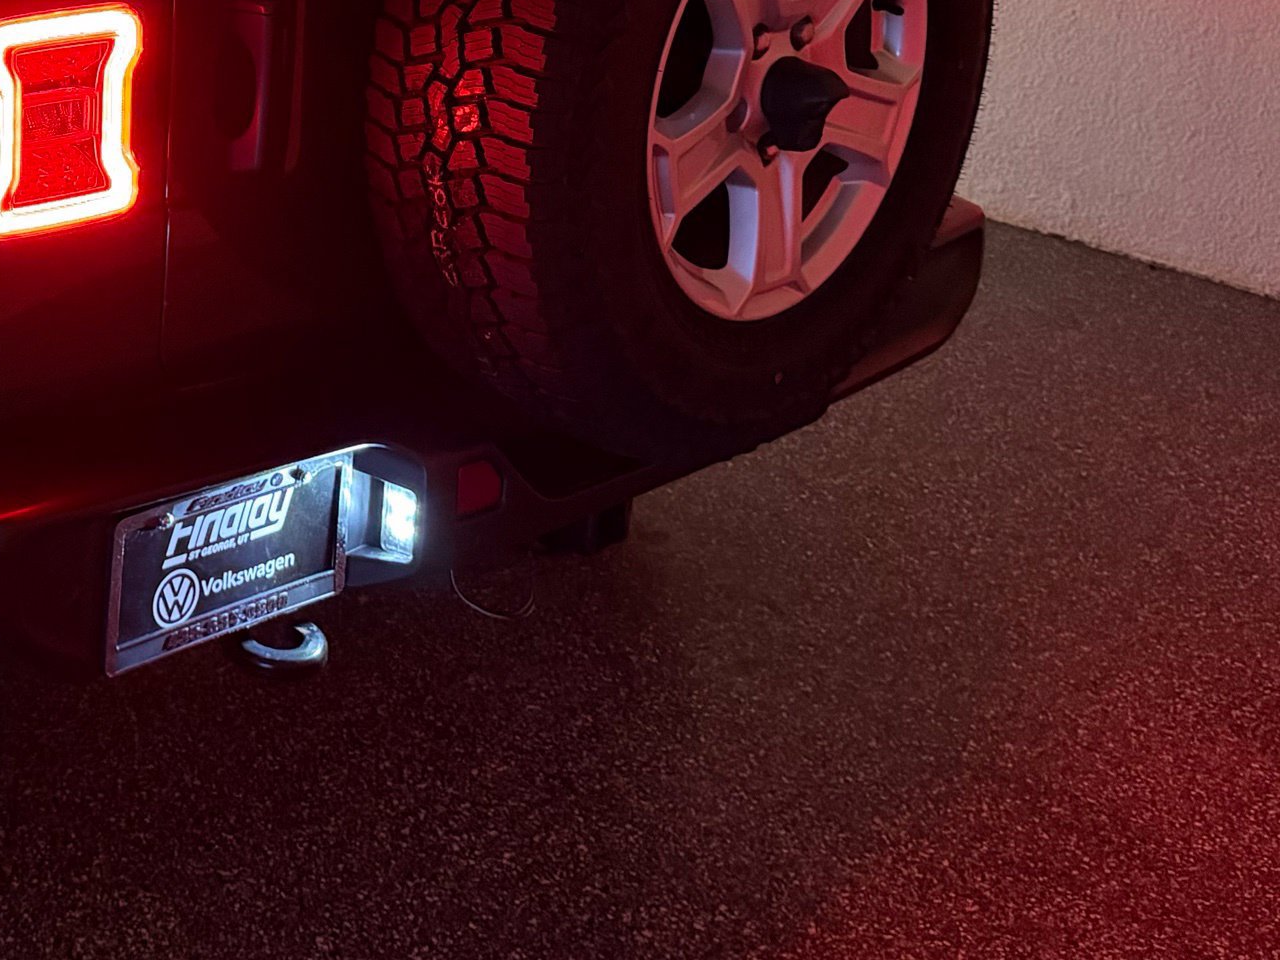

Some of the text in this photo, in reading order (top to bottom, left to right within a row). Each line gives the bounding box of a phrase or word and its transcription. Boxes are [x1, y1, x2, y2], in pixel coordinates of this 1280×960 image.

[162, 486, 295, 569] Findlay
[155, 571, 198, 626] VW
[201, 552, 296, 597] Volkswagen
